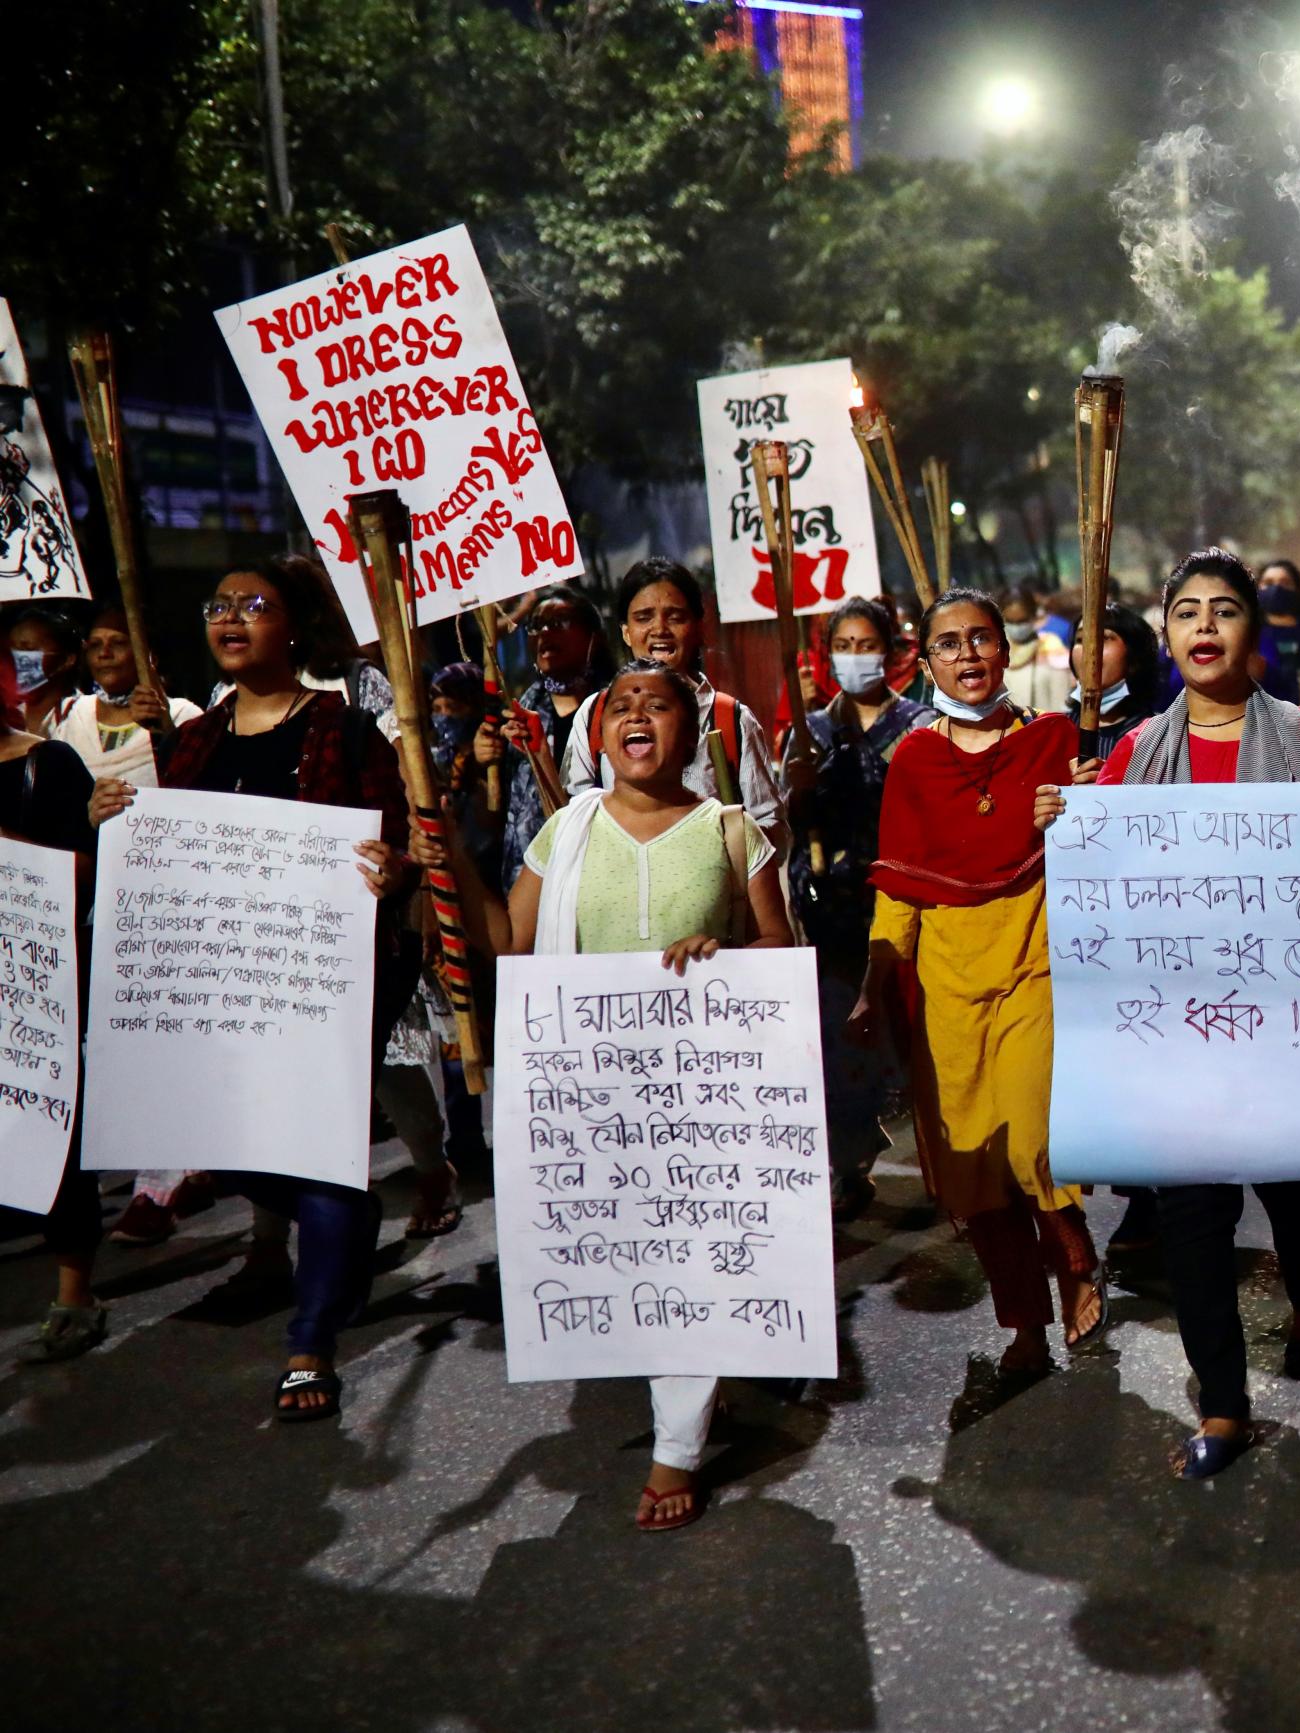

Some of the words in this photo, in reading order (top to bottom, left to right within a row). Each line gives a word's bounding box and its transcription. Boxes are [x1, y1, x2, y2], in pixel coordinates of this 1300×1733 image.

[277, 359, 309, 400] I
[316, 314, 462, 387] DRESS
[284, 365, 518, 452] WHEREVER
[724, 394, 789, 431] গায়ে
[343, 450, 365, 485] I
[372, 429, 425, 481] GO
[471, 407, 542, 484] YES
[513, 516, 574, 576] NO
[1052, 801, 1112, 852] এই
[1124, 811, 1187, 852] দায়
[1193, 812, 1298, 854] আমার
[1057, 878, 1116, 912] নয়
[1120, 876, 1265, 915] চলন-বলন
[5, 961, 15, 982] ও
[19, 964, 51, 992] তার
[1055, 925, 1115, 970] এই
[1125, 936, 1205, 971] দায়
[1213, 934, 1276, 985] শুধু
[573, 988, 693, 1034] মাদ্রাসার
[703, 978, 789, 1033] শিশুসহ
[1115, 984, 1171, 1045] তুই
[1185, 989, 1270, 1043] ধর্ষক
[50, 1061, 61, 1080] ও
[522, 1050, 582, 1079] সকল
[592, 1041, 663, 1079] শিশুর
[675, 1039, 762, 1076] নিরাপত্তা
[524, 1076, 620, 1114] নিশ্চিত
[631, 1083, 683, 1109] করা
[697, 1082, 746, 1112] এবং
[753, 1085, 807, 1107] কোন
[529, 1117, 586, 1158] শিশু
[583, 1112, 644, 1153] যৌন
[646, 1111, 758, 1153] নির্যাতনের
[530, 1162, 586, 1194] হলে
[667, 1153, 740, 1193] দিনের
[540, 1231, 694, 1276] অভিযোগের
[533, 1279, 618, 1342] বিচার
[632, 1281, 716, 1328] নিশ্চিত
